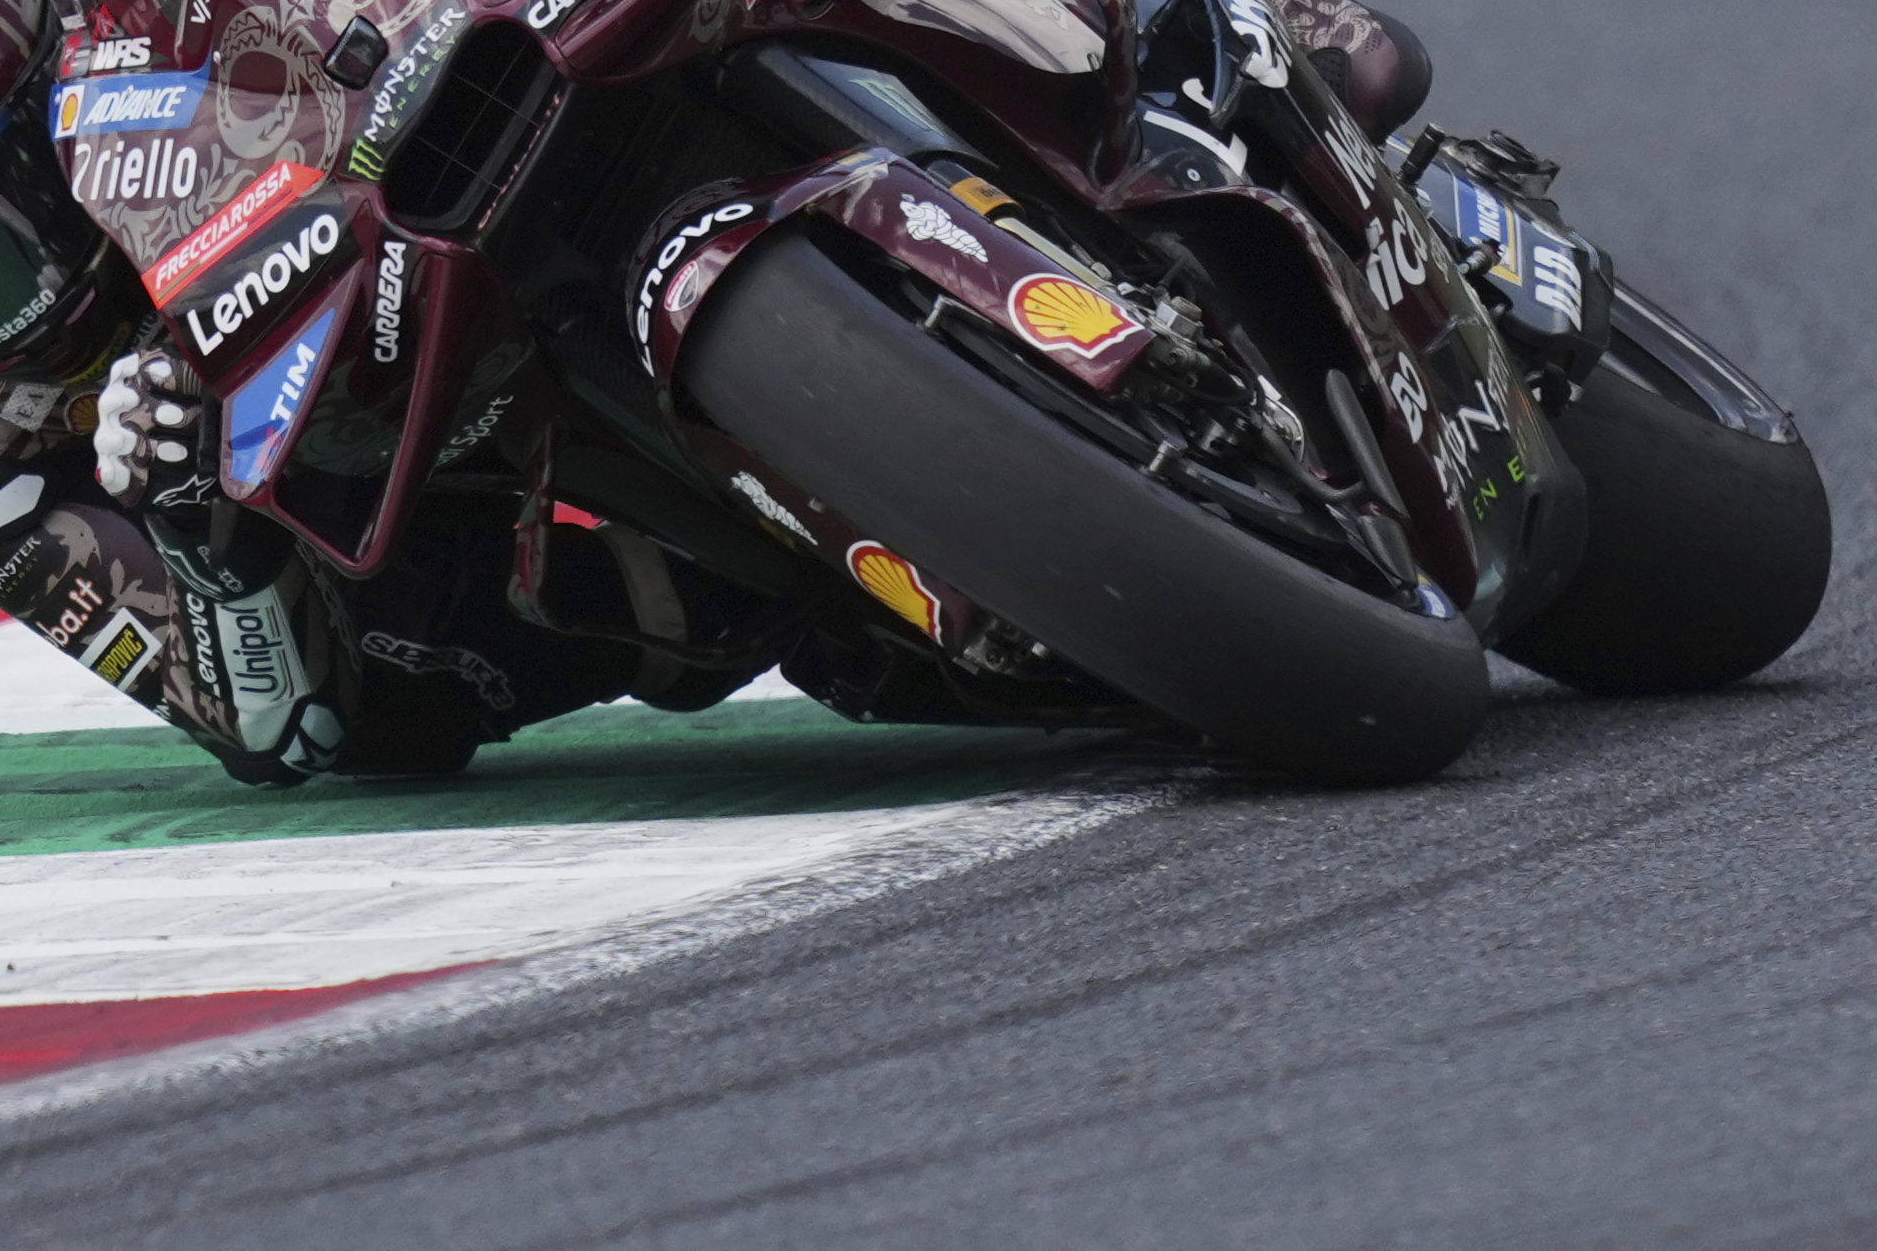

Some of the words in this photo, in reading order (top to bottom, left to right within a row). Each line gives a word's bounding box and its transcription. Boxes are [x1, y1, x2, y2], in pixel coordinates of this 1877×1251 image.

[92, 36, 152, 71] WRS
[84, 86, 188, 126] ADVANCE
[156, 162, 292, 290] FRECCIAROSSA
[187, 214, 340, 357] Lenovo
[375, 241, 407, 363] CARRERA
[638, 203, 754, 379] Lenovo
[271, 343, 317, 422] TIM
[463, 395, 514, 446] Sport
[221, 605, 283, 694] Unipol
